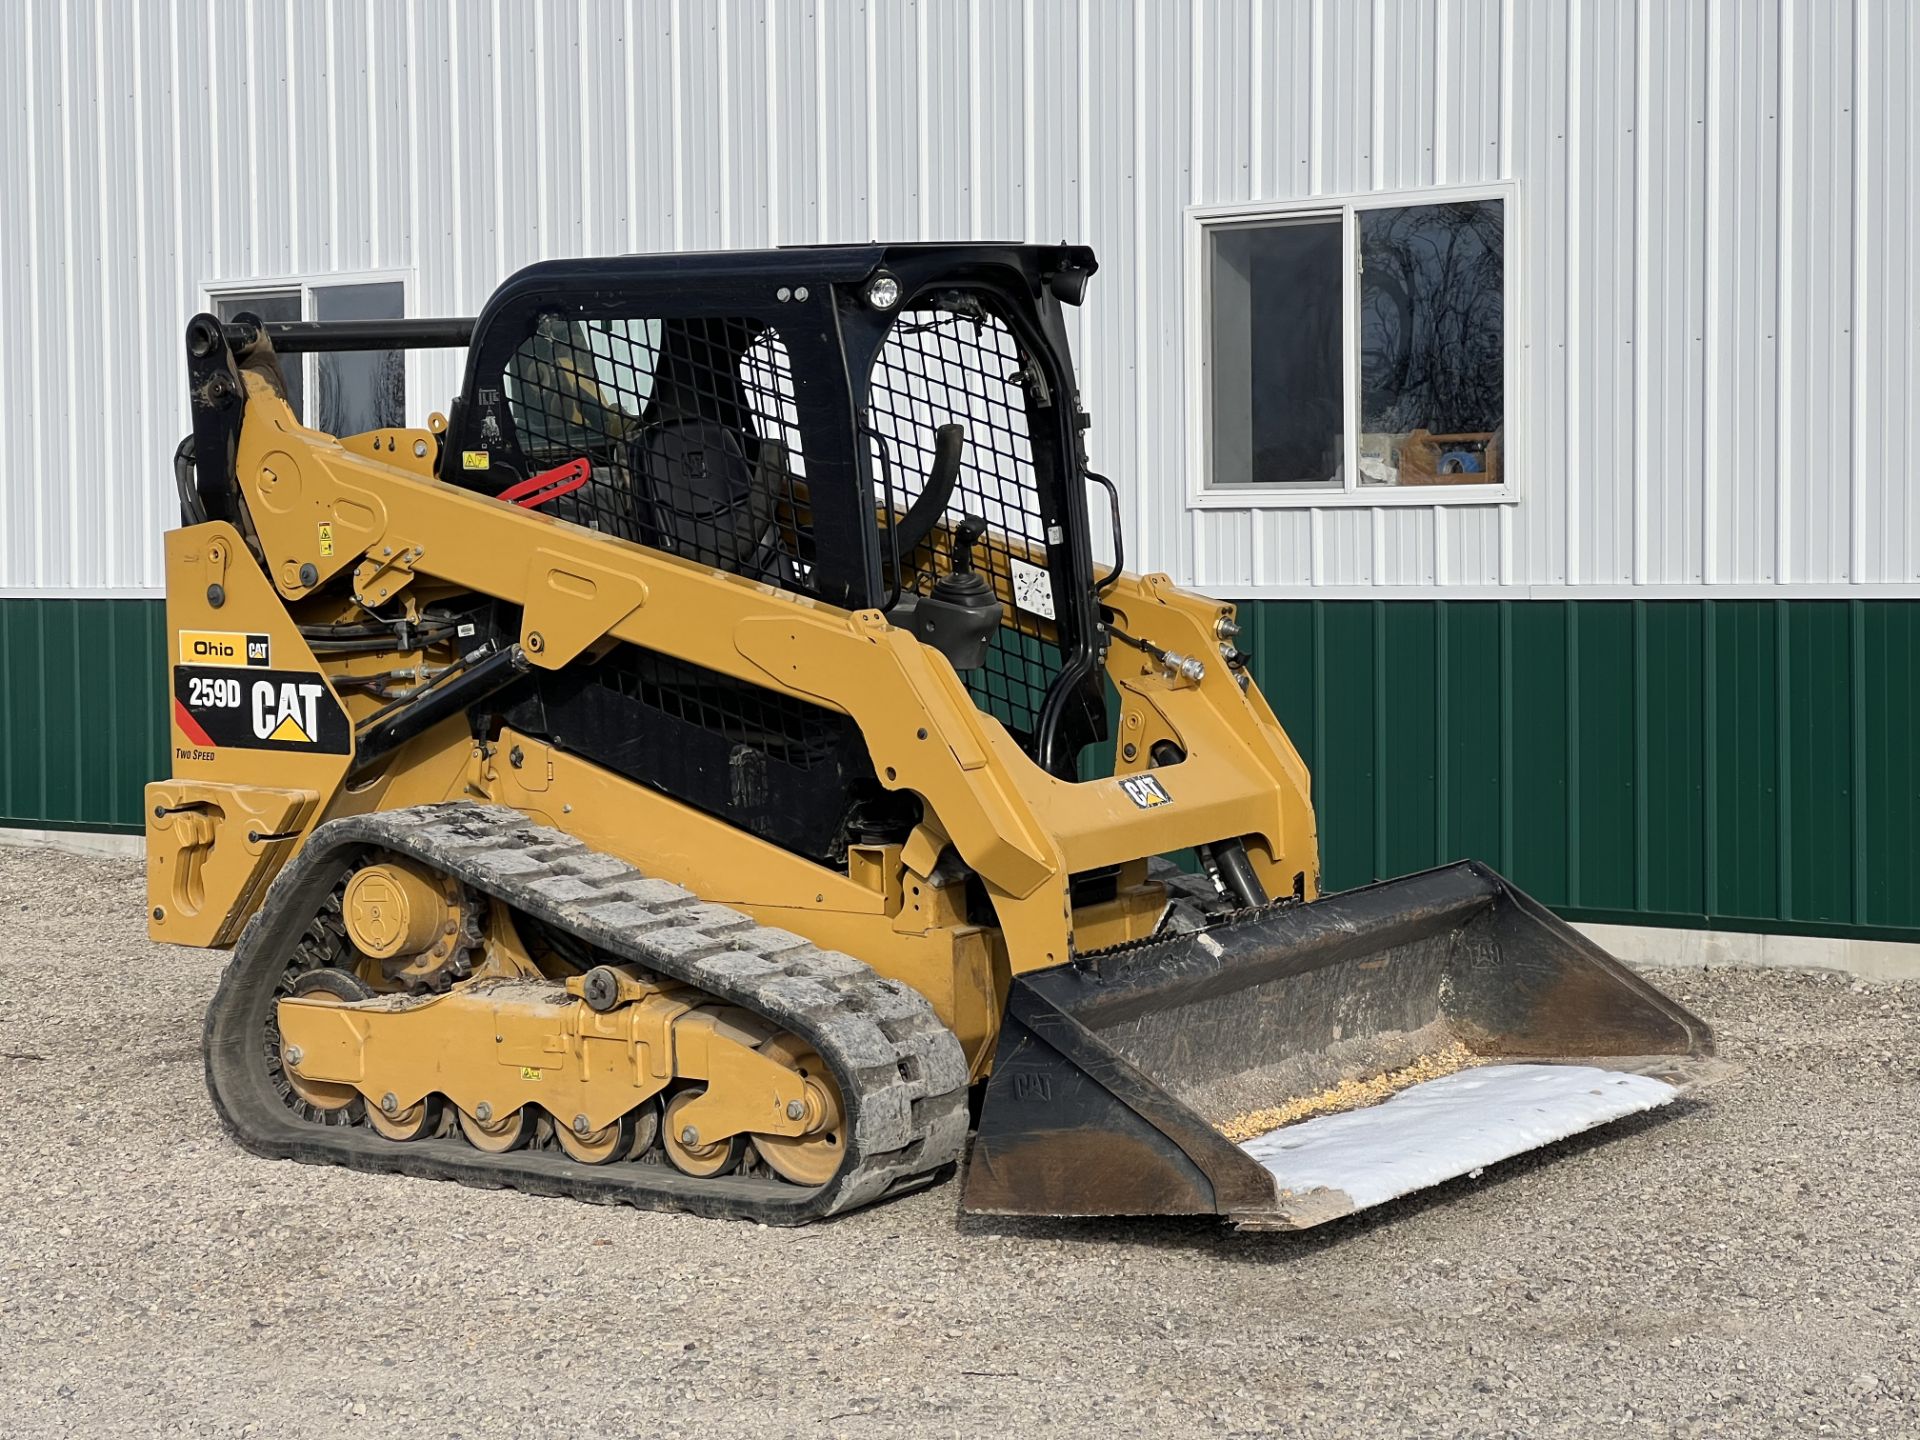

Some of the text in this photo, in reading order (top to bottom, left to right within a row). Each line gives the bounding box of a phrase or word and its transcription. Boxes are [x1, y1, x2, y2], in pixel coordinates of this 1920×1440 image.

[194, 641, 268, 658] Ohio CAT
[189, 678, 323, 743] 259D CAT
[1124, 776, 1168, 807] CAT
[1013, 1072, 1052, 1102] CAT
